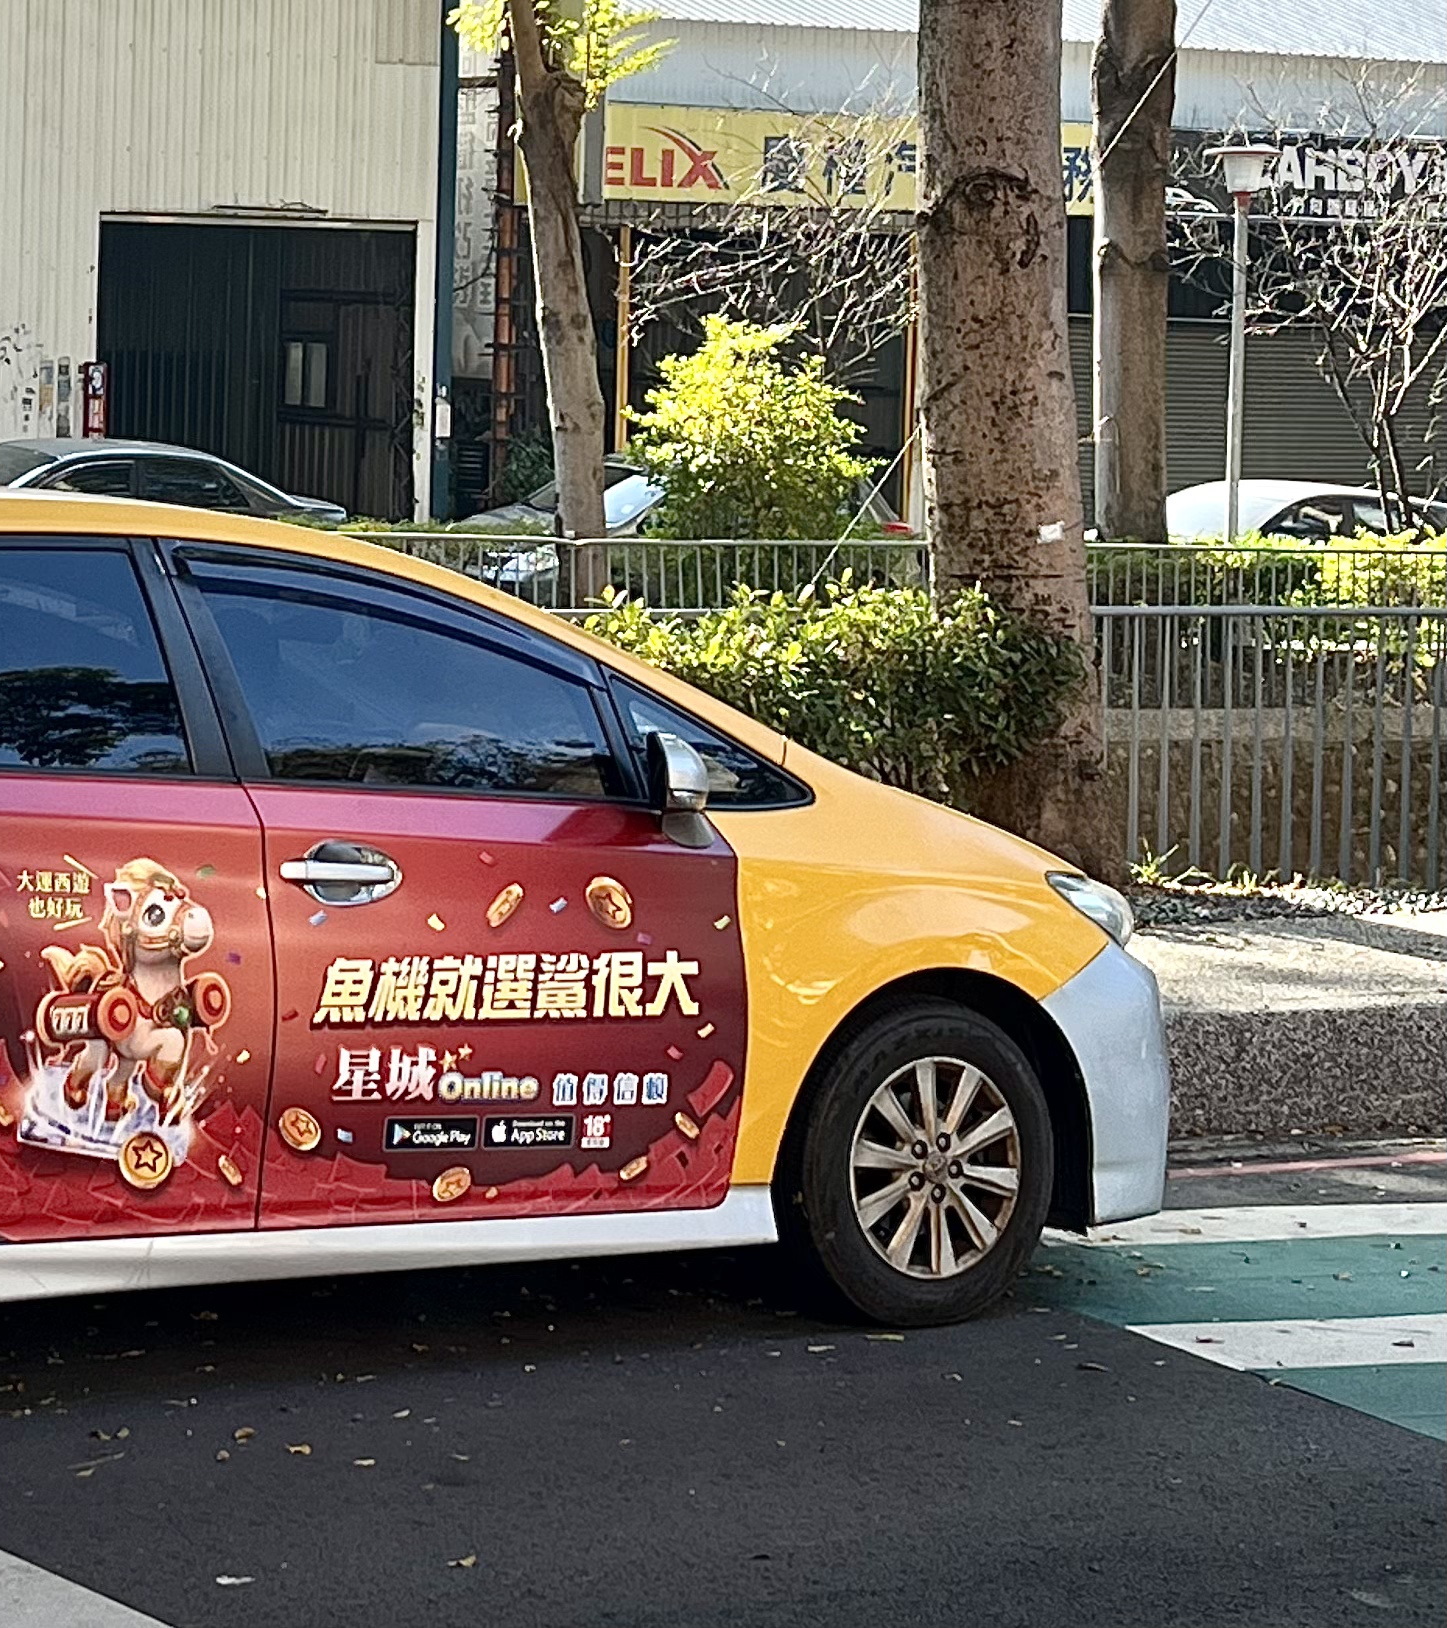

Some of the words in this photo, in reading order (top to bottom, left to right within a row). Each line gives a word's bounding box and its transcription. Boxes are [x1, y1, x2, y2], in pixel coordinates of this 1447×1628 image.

[28, 895, 84, 919] 也好玩
[313, 950, 700, 1024] 魚機就選鯊很大
[332, 1045, 438, 1102] 星城
[438, 1071, 540, 1101] Online
[412, 1130, 450, 1146] Google
[450, 1130, 471, 1145] Play
[511, 1128, 535, 1144] App
[535, 1127, 566, 1142] Store
